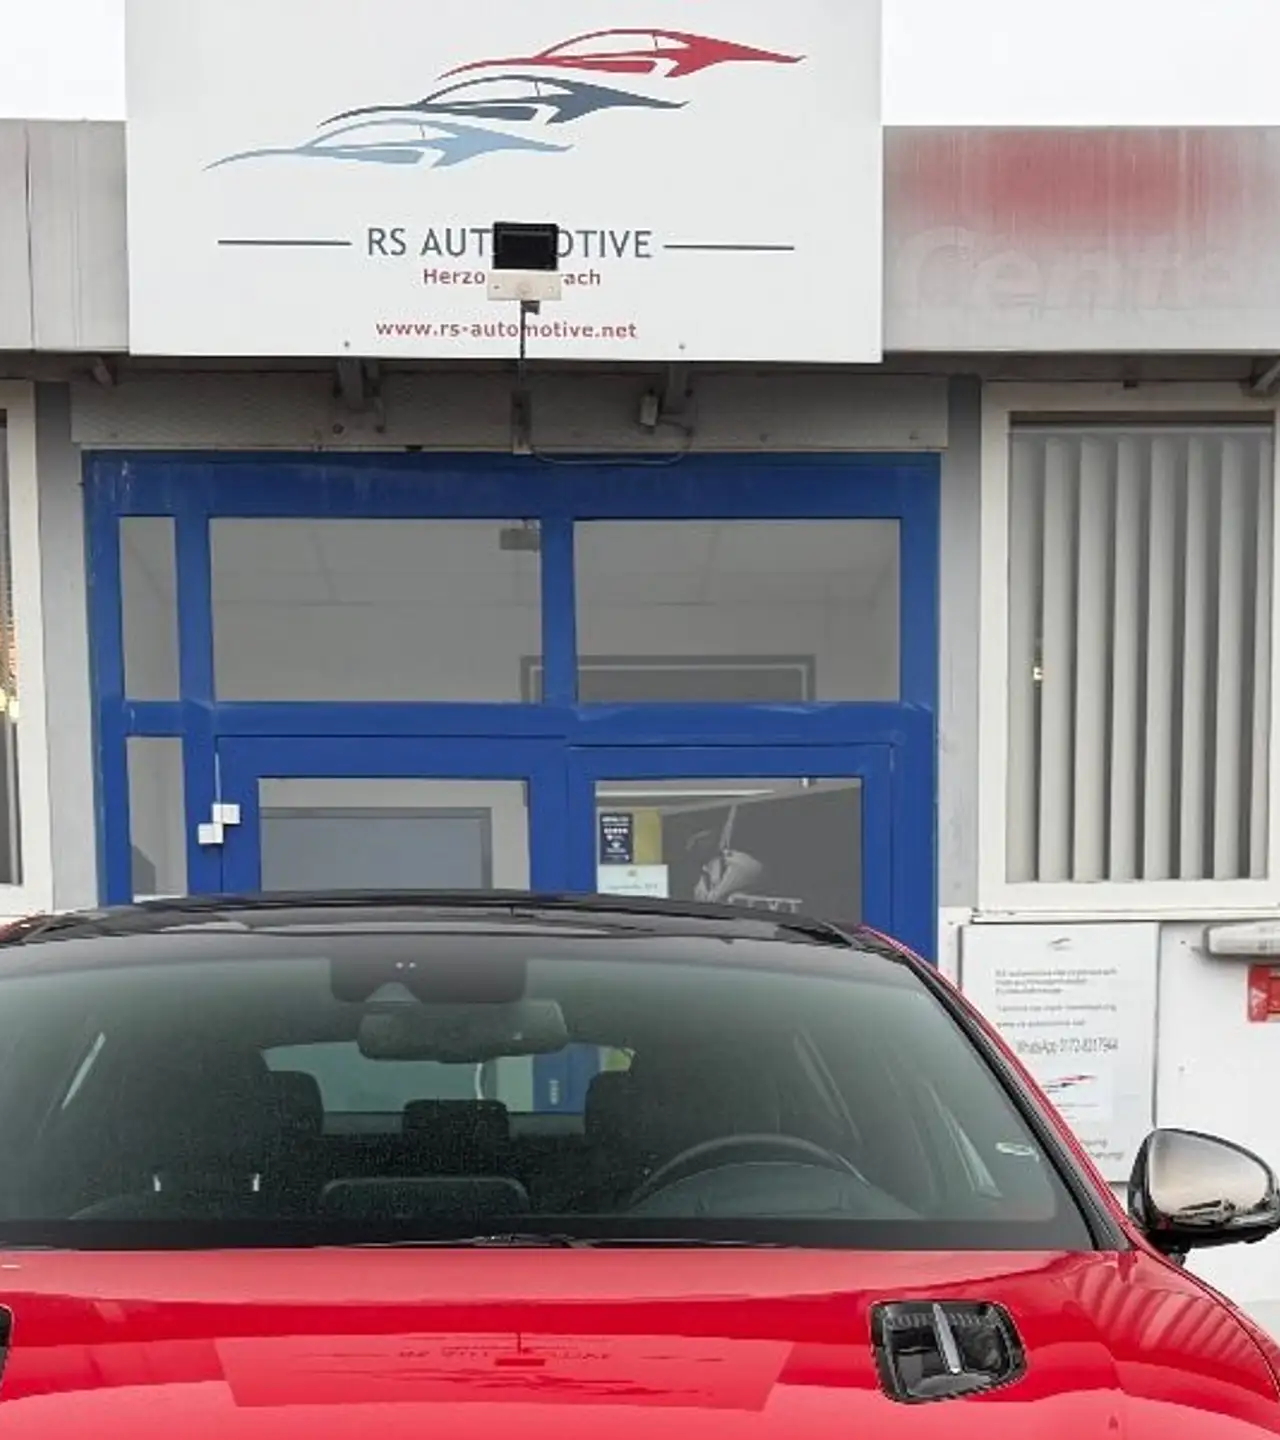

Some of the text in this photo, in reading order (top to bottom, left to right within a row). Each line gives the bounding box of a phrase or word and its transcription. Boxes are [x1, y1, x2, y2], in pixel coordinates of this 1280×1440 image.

[368, 227, 653, 259] RS AUTOTIVE
[375, 320, 638, 340] www.rs-automotive.net
